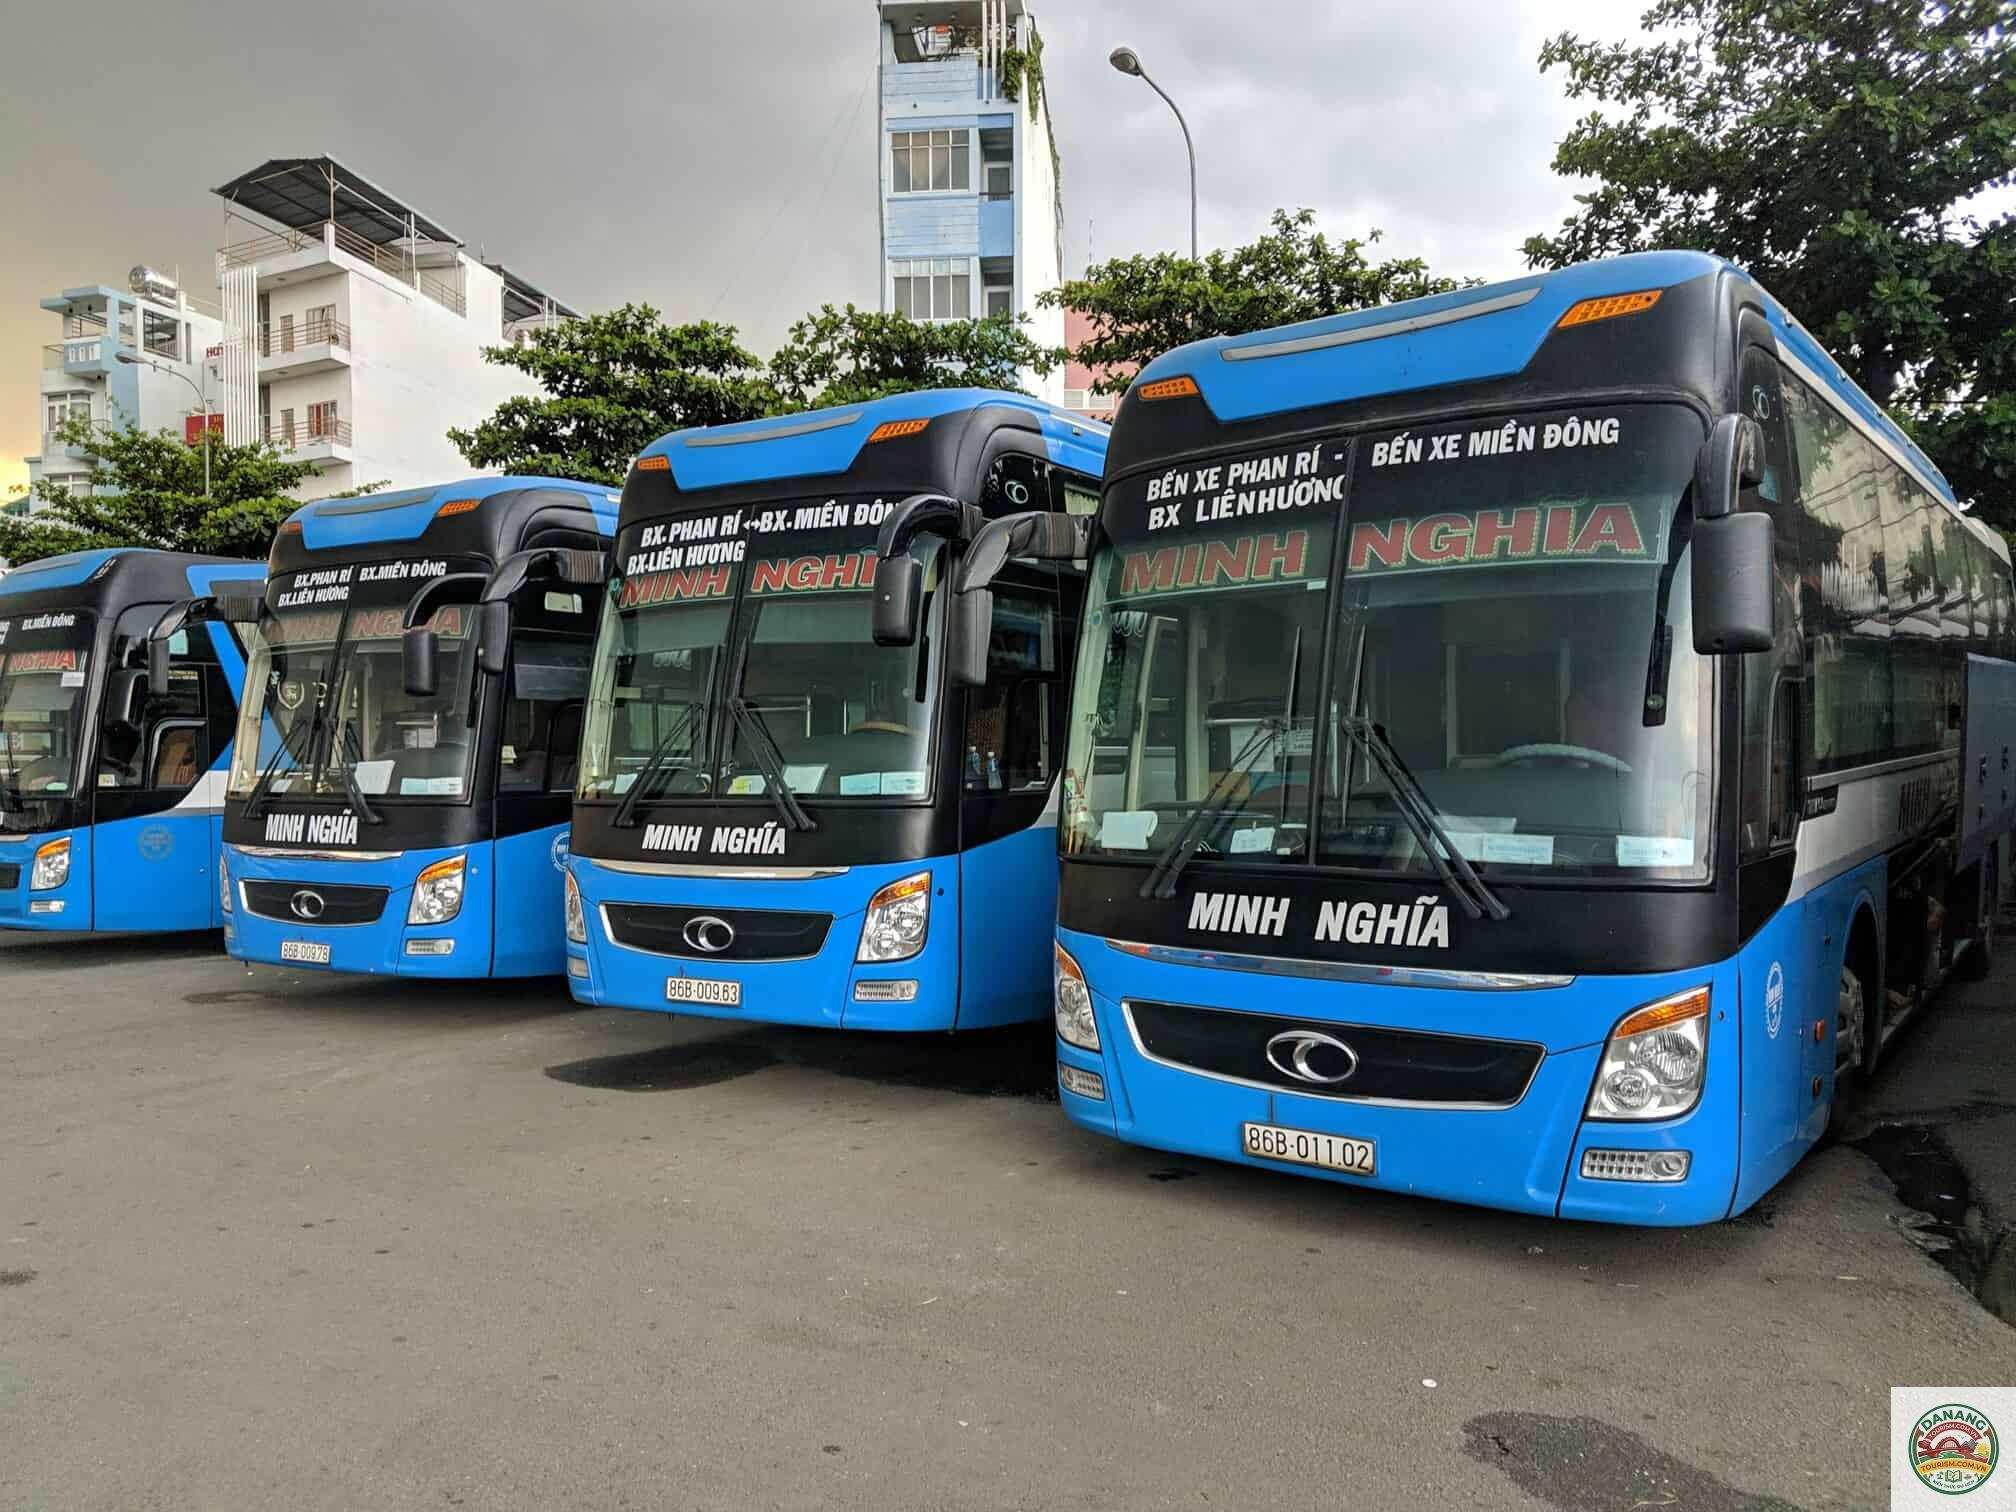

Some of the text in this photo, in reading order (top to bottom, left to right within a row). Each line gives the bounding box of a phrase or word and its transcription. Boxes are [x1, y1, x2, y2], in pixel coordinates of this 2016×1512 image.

[1147, 468, 1189, 502] BẾN
[1193, 466, 1222, 493] XE
[1227, 454, 1289, 487] PHAN
[1294, 443, 1323, 476] RÍ
[1371, 431, 1424, 467] BẾN
[1428, 434, 1462, 461] XE
[1467, 419, 1536, 457] MIỀN
[1543, 416, 1620, 449] ĐÔNG
[720, 509, 743, 536] RÍ
[1148, 503, 1183, 530] BX
[685, 540, 746, 567] HƯƠNG
[1119, 530, 1309, 597] MINH
[338, 565, 354, 583] RÍ
[619, 565, 731, 609] MINH
[265, 809, 359, 845] MINH NGHĨA
[641, 821, 786, 855] MINH NGHĨA
[1187, 892, 1449, 948] MINH NGHĨA
[669, 979, 738, 1002] 86B-009.63
[1249, 1127, 1369, 1170] 86B-011.02
